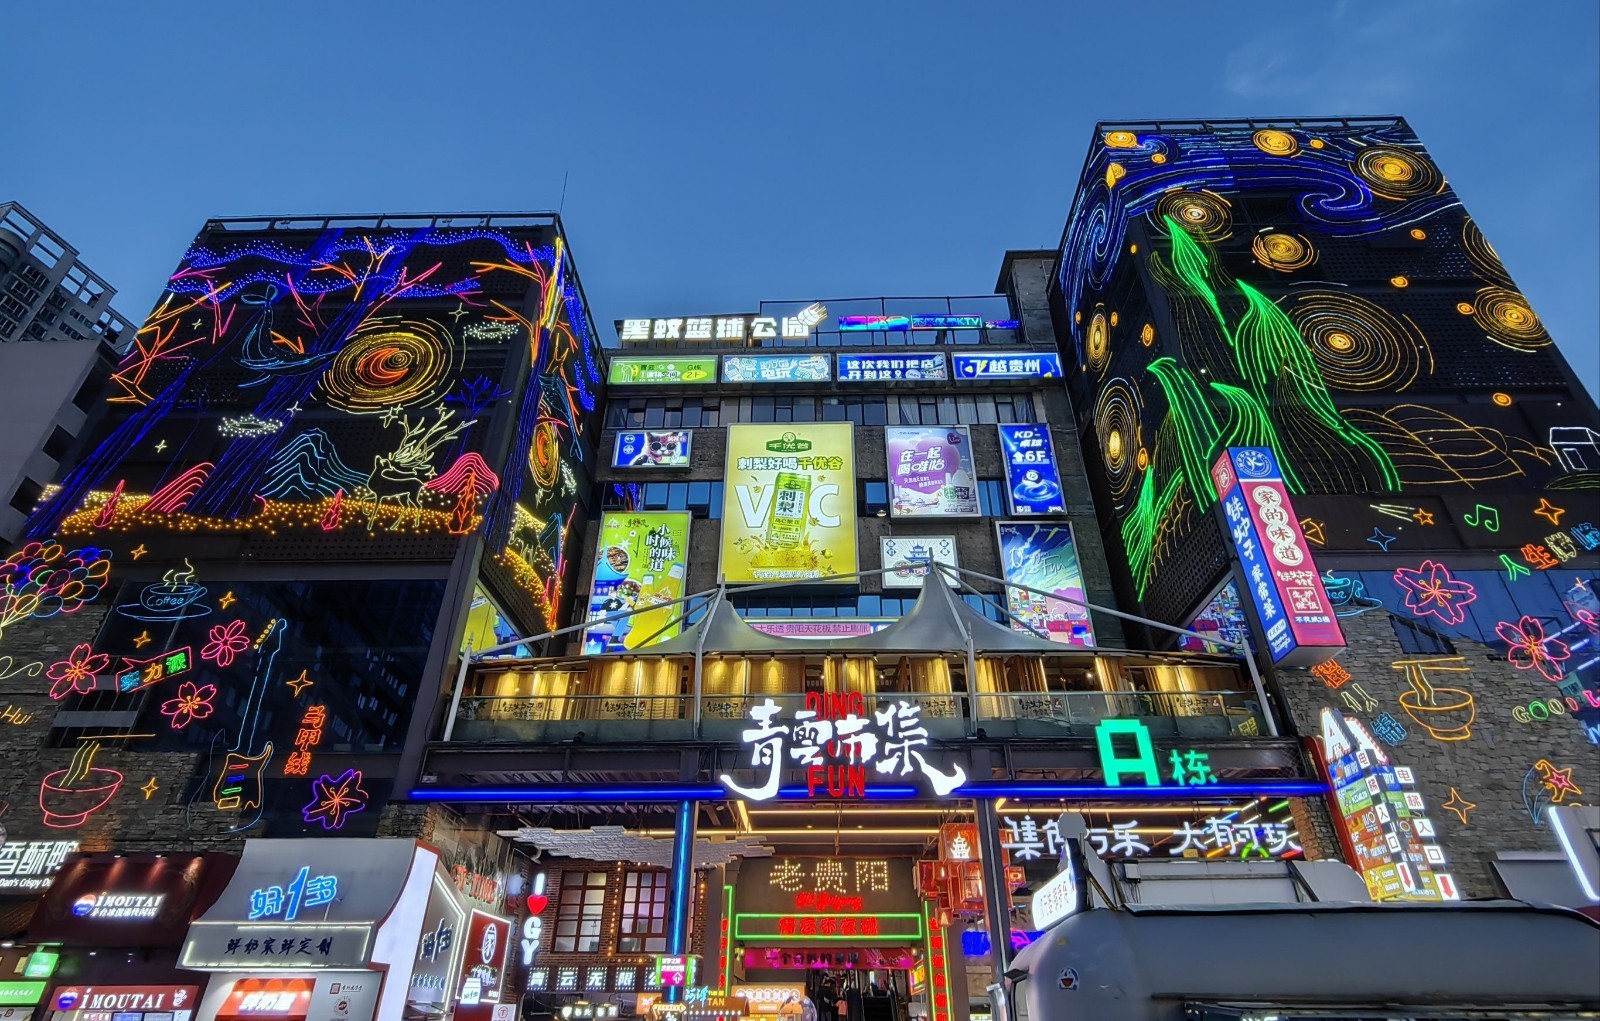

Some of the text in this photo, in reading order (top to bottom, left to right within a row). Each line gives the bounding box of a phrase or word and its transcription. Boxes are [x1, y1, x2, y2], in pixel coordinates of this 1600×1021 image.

[847, 359, 934, 369] 这次我们把店
[969, 359, 1040, 377] 飞越贵州
[848, 370, 891, 380] 开到这
[900, 447, 942, 462] 在一起
[1025, 450, 1045, 461] 6F
[737, 457, 843, 470] 刺梨好喝千优谷
[1257, 490, 1300, 563] 家的味道
[786, 624, 831, 633] 贵阳天花板
[807, 765, 865, 797] FUN
[1169, 817, 1303, 855] 大有可玩
[19, 878, 42, 889] Crispy
[769, 859, 888, 893] 老贵阳
[249, 866, 337, 920] 好1多
